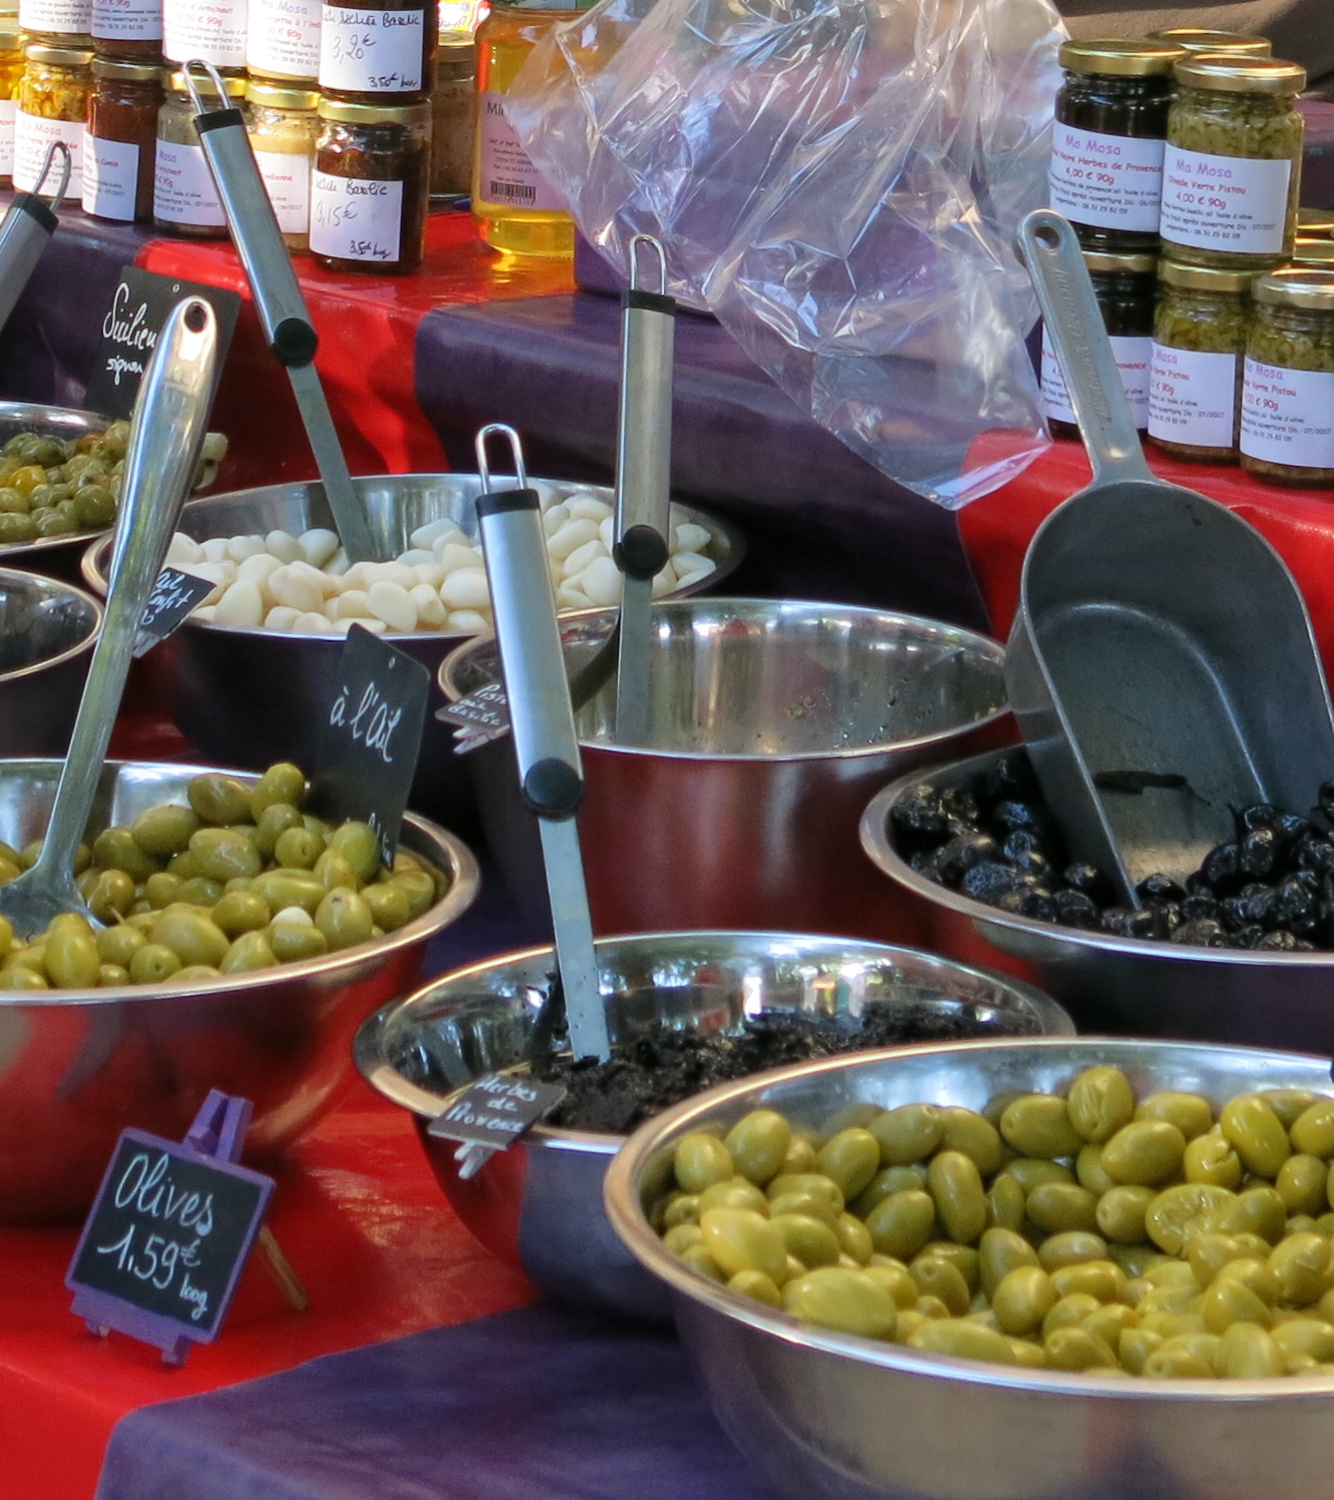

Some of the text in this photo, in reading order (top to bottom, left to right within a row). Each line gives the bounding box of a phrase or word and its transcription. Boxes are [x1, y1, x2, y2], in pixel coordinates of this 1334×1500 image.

[278, 1, 308, 15] Mosa
[35, 122, 62, 136] Mosa
[1066, 135, 1122, 156] Ma Mosa
[1078, 156, 1108, 170] Herbes
[1111, 161, 1123, 171] de
[1176, 159, 1233, 179] Ma Mosa
[1096, 171, 1115, 186] 90g
[1191, 179, 1215, 192] Verte
[1207, 196, 1227, 211] 90g
[1116, 362, 1147, 371] rovence
[1255, 364, 1283, 380] Mosa
[1271, 384, 1297, 397] Pistou
[1263, 399, 1279, 412] 90g
[487, 1098, 517, 1112] de
[114, 1152, 214, 1237] Olives
